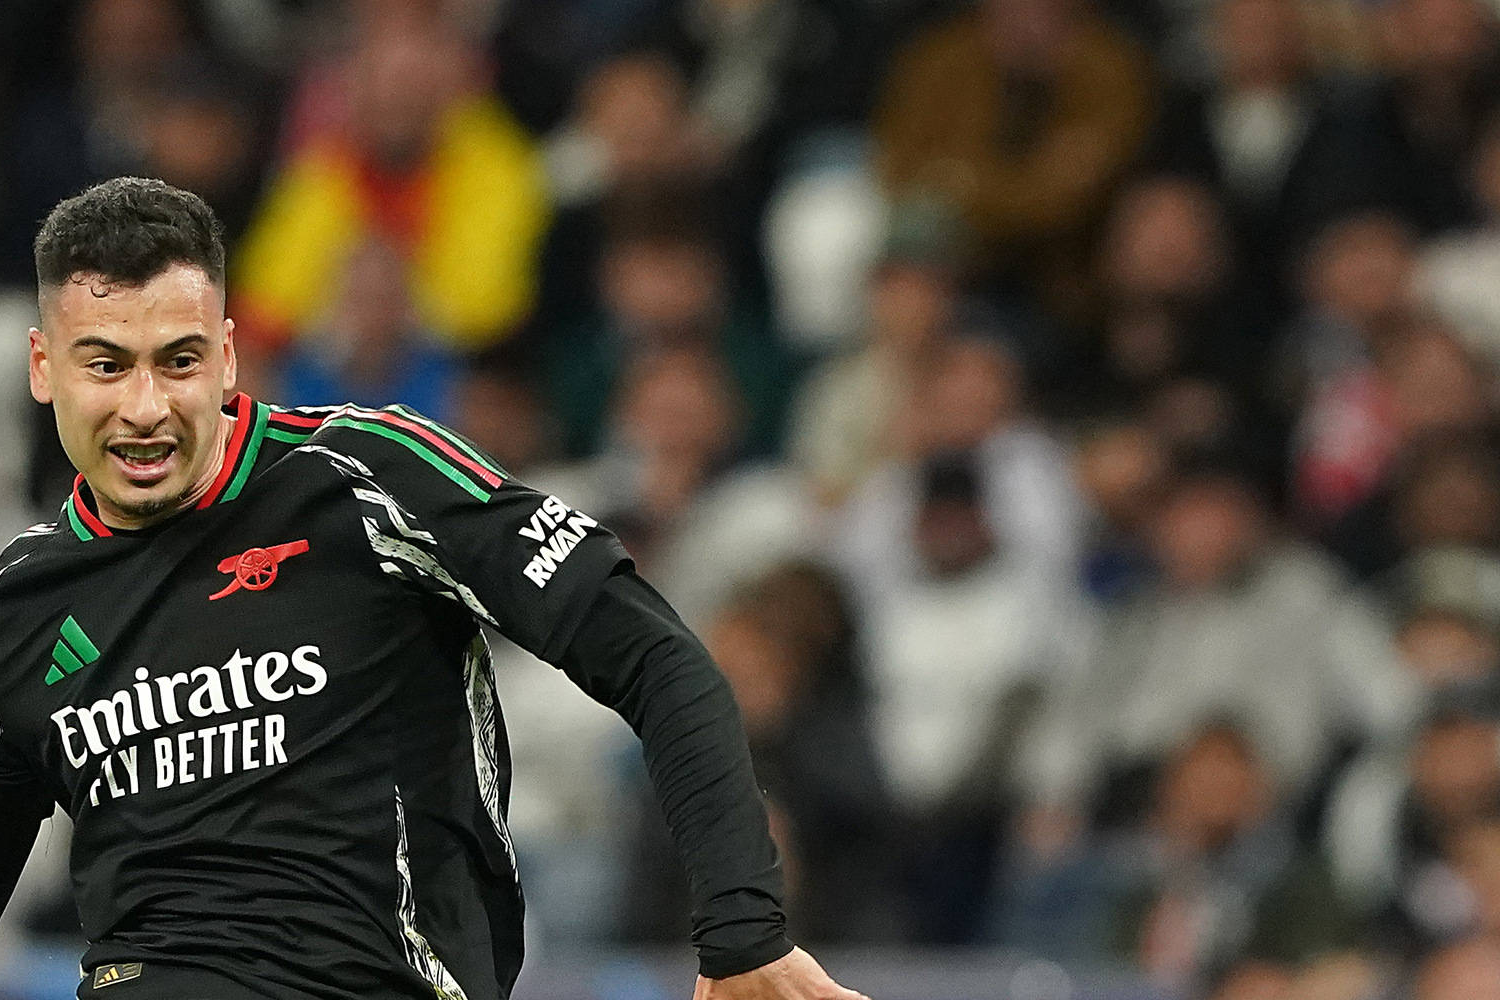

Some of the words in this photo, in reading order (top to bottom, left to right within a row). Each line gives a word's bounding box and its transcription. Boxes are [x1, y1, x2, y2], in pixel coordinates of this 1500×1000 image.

[522, 510, 598, 589] RWAN
[50, 645, 328, 769] Emirates
[153, 713, 288, 789] BETTER
